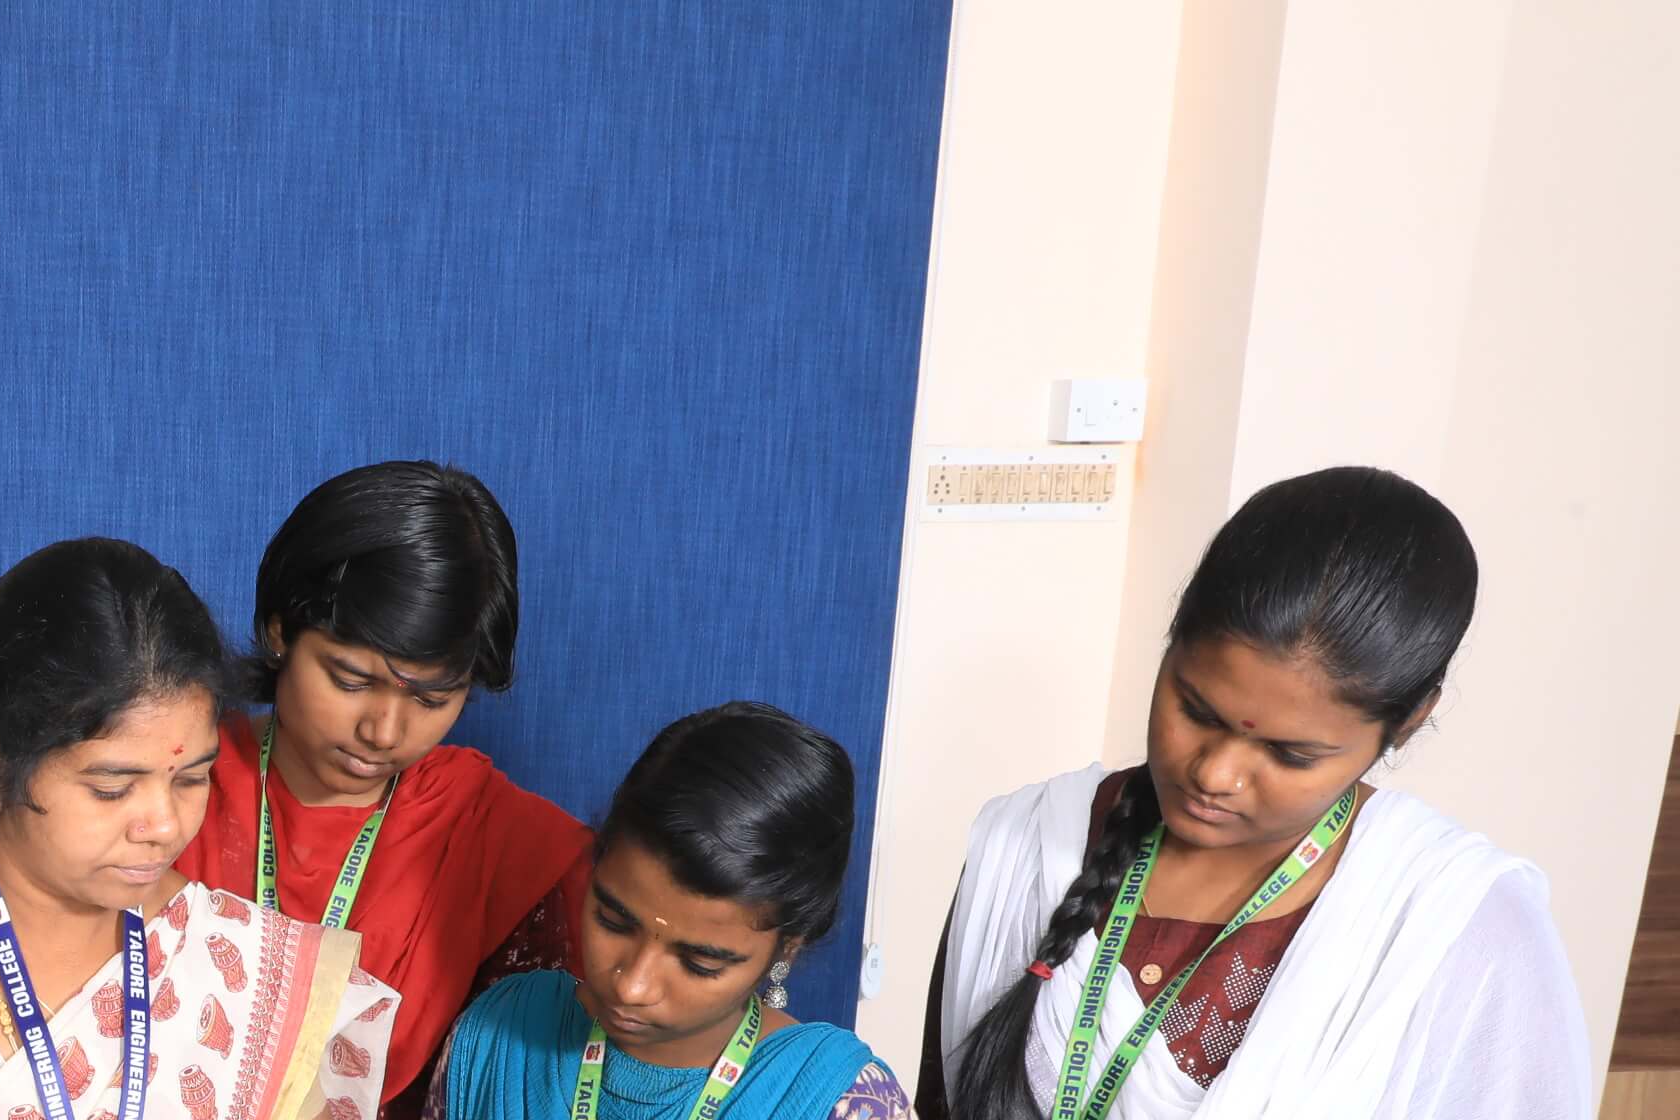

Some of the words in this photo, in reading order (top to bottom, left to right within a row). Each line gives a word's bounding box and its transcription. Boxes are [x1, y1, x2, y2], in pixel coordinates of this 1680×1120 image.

[340, 825, 376, 888] TAGORE
[1120, 839, 1156, 906] TAGORE
[128, 929, 146, 1000] TAGORE
[1078, 916, 1129, 1030] ENGINEERING
[1127, 953, 1200, 1049] ENGINEE
[1222, 871, 1293, 937] COLLEGE
[1058, 1040, 1089, 1120] COLLEGE
